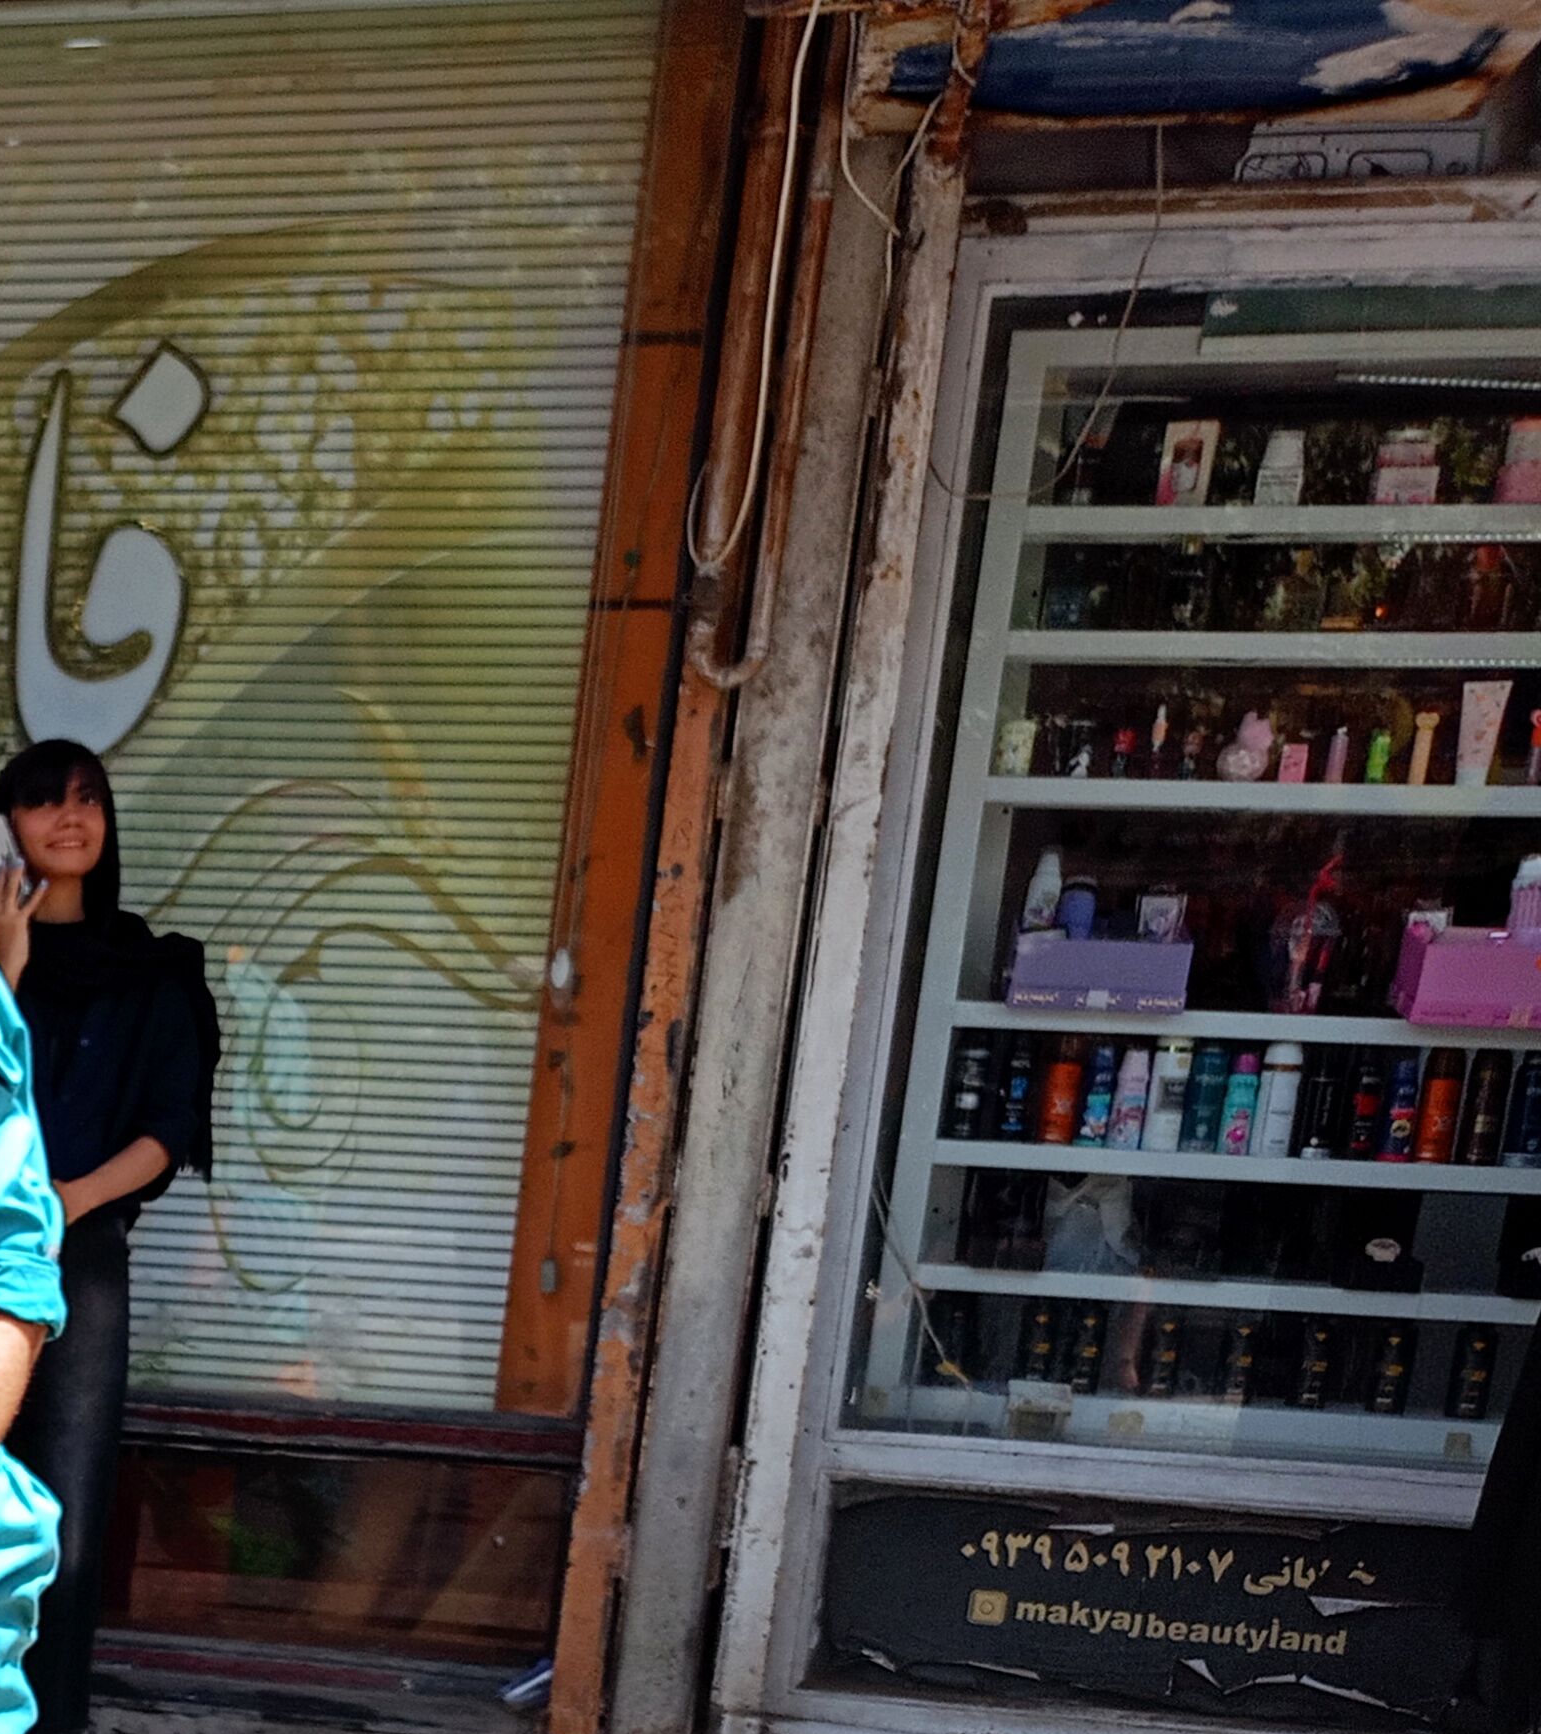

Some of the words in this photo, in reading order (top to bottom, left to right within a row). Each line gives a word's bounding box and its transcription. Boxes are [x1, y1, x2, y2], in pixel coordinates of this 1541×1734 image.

[960, 1531, 1052, 1570] ۰۹۳۹
[1064, 1540, 1130, 1577] ۵۰۹
[1015, 1600, 1349, 1656] makyajbeautyland
